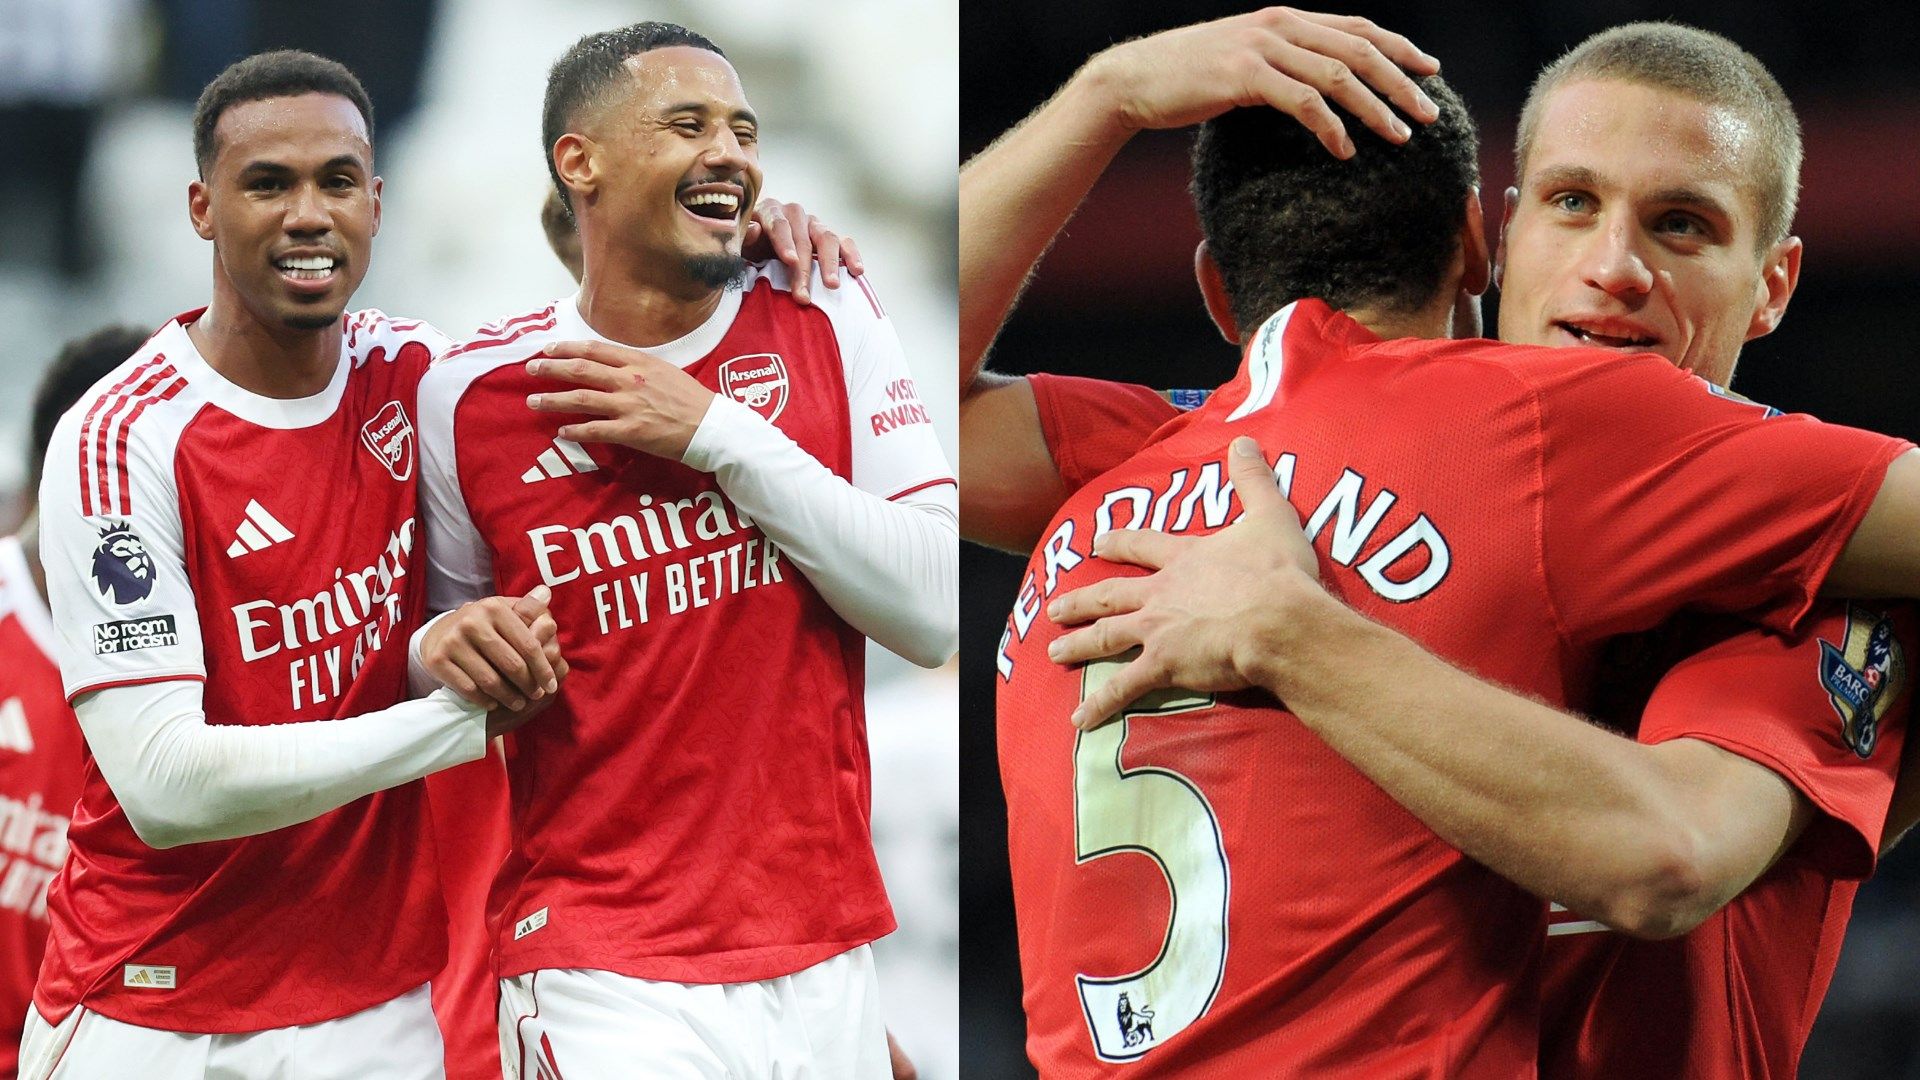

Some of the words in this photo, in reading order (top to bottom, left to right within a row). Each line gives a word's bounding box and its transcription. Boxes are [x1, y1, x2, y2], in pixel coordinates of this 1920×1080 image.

[729, 363, 777, 383] Arsenal
[371, 411, 402, 443] Arsenal
[593, 571, 650, 635] FLY
[664, 536, 783, 615] BETTER
[93, 624, 120, 640] No
[121, 619, 168, 637] room
[95, 637, 120, 655] for
[122, 632, 178, 651] racism
[289, 645, 341, 711] FLY
[1074, 645, 1231, 1063] 5
